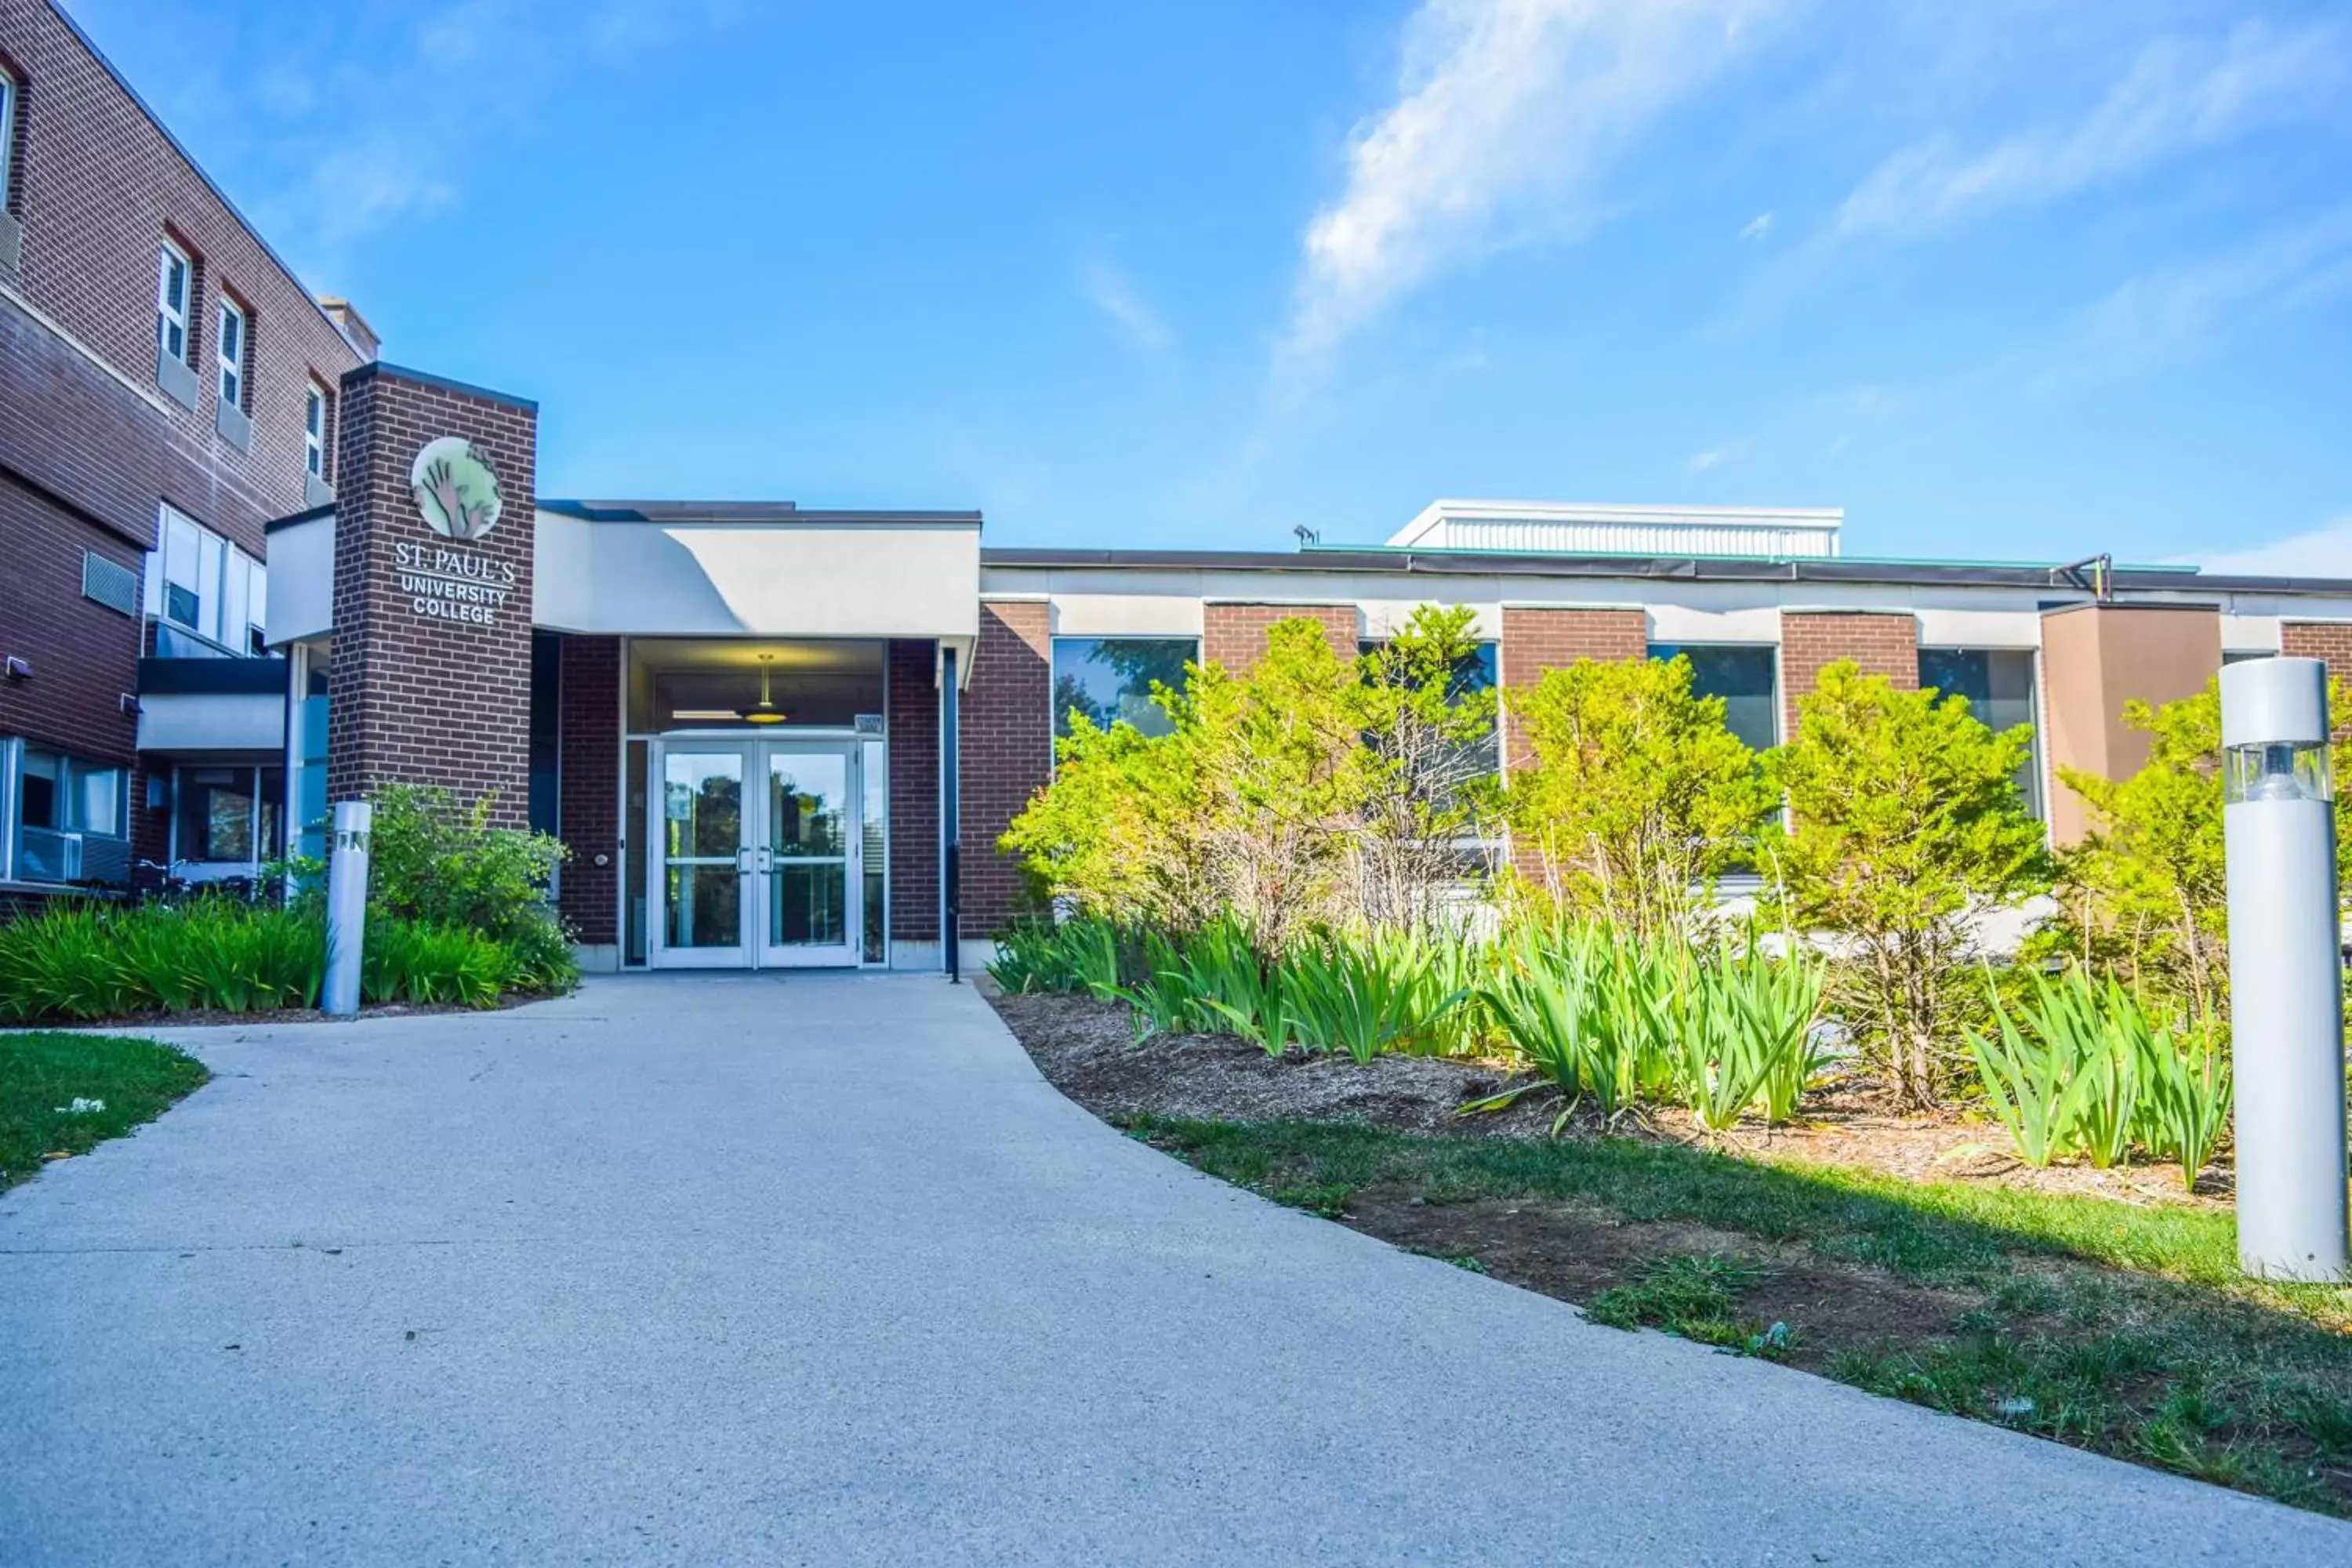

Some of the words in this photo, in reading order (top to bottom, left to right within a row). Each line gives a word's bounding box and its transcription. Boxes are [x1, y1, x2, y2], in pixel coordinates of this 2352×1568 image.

[396, 542, 428, 568] ST.
[435, 550, 514, 583] PAUL'S
[401, 574, 506, 606] UNIVERSITY
[413, 597, 494, 625] COLLEGE
